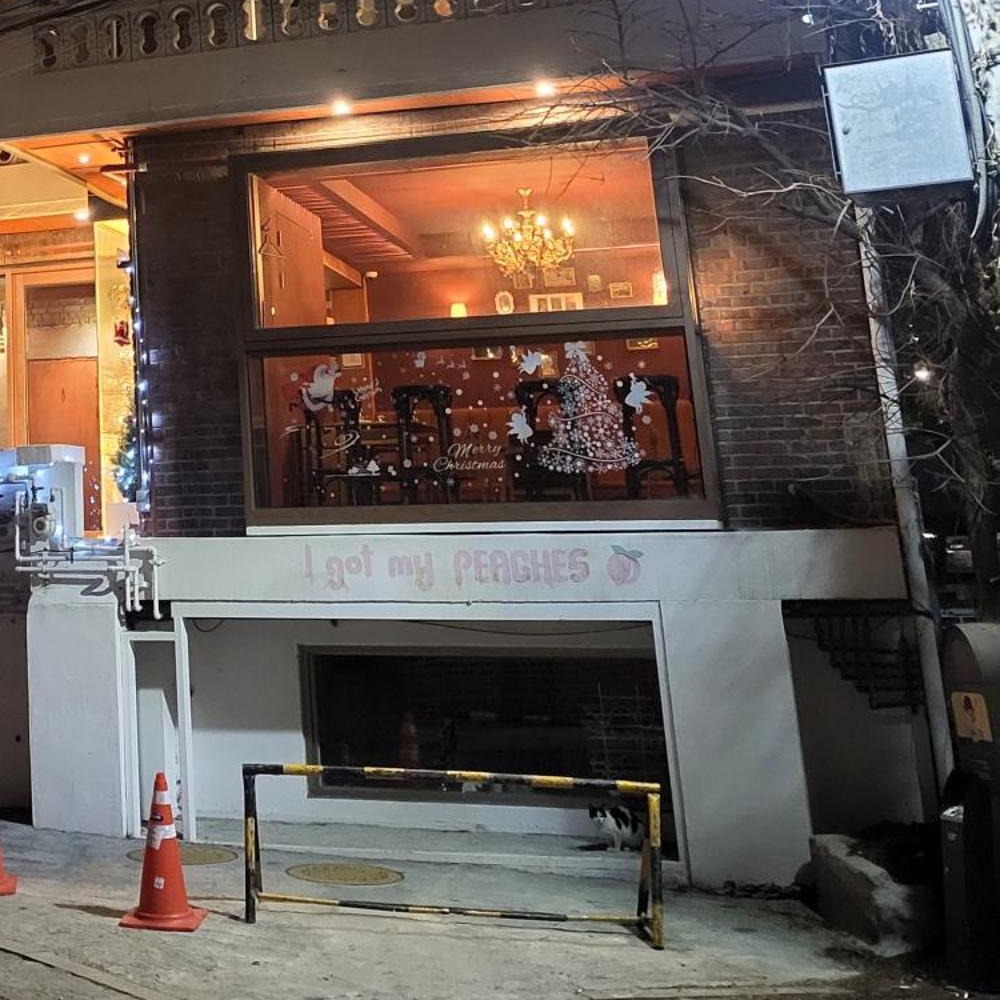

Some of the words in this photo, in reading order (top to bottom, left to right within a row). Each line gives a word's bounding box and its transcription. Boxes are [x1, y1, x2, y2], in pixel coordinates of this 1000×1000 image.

[447, 443, 503, 460] Merry
[432, 456, 504, 472] Christmas
[326, 543, 374, 591] got
[387, 551, 434, 591] my
[454, 548, 591, 587] PEACHES
